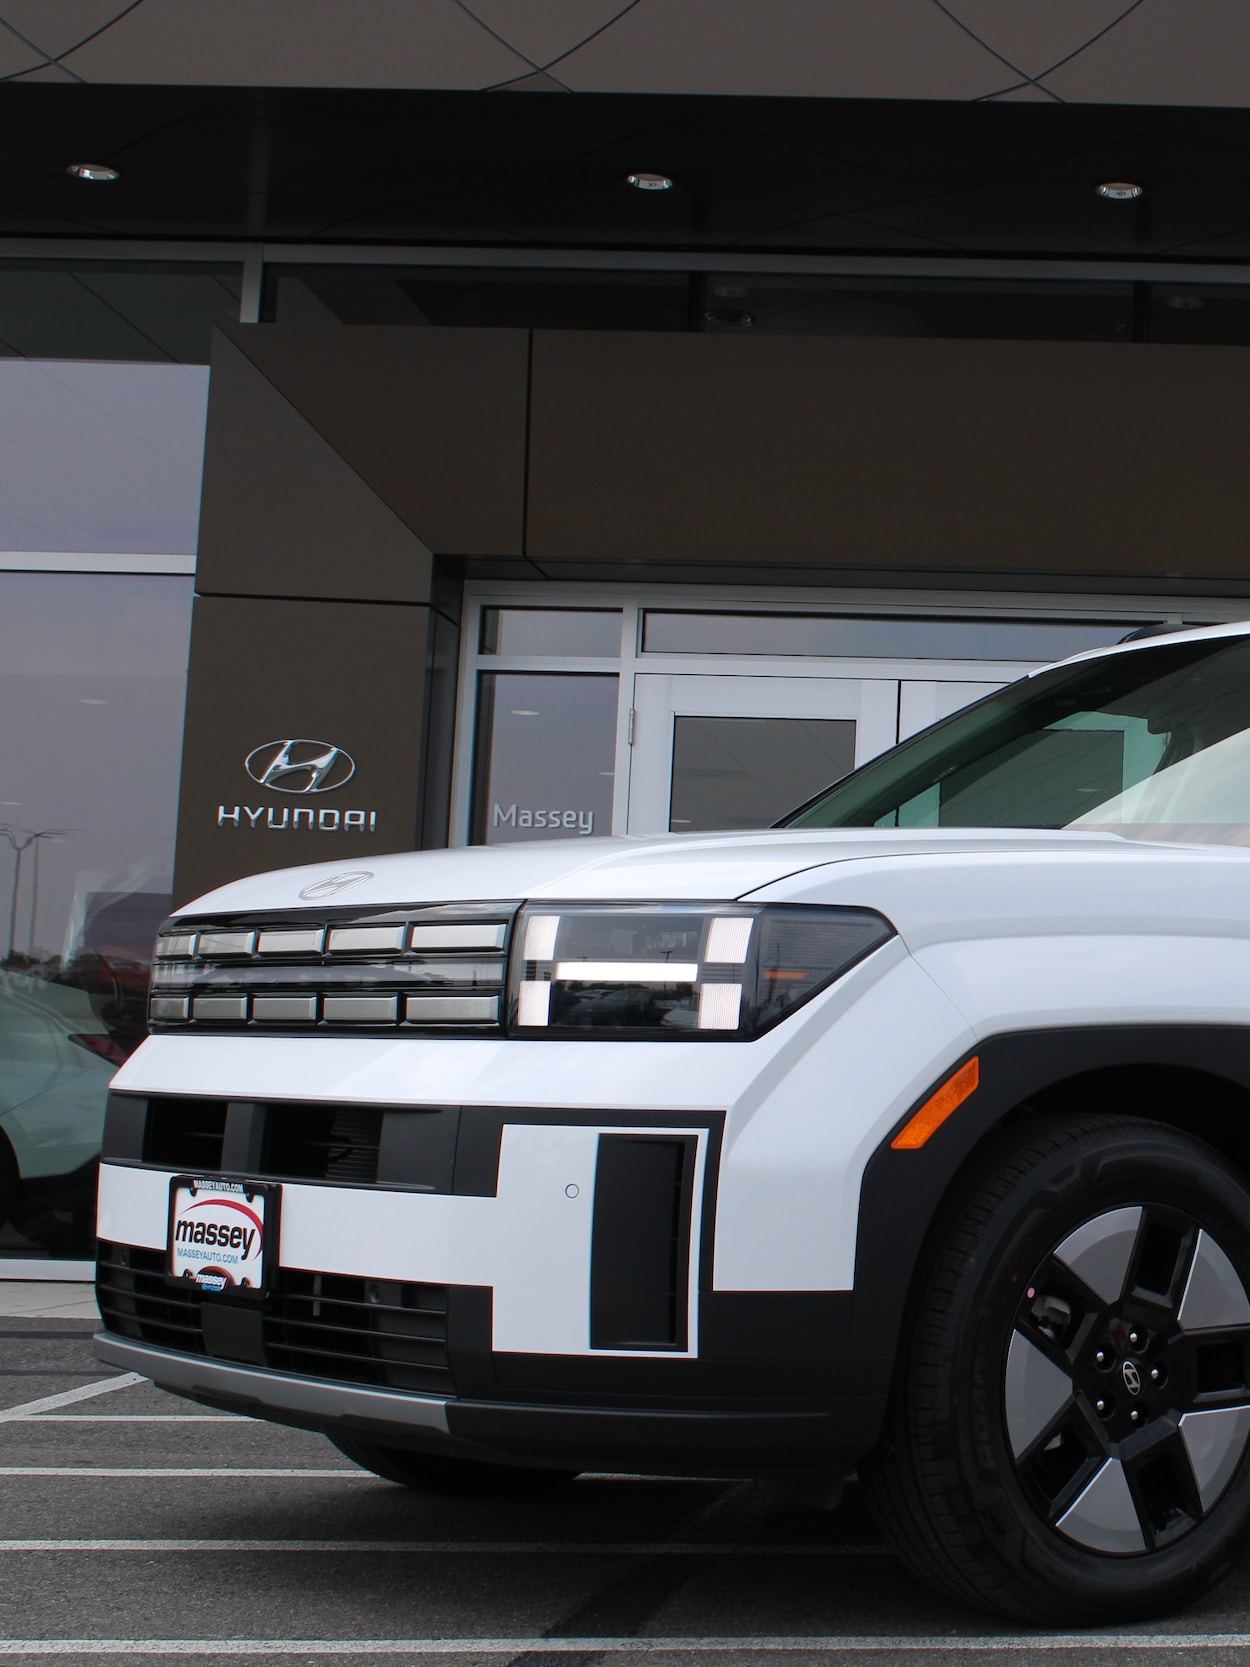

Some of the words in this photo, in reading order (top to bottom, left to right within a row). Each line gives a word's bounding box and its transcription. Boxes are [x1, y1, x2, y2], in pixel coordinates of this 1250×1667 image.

[217, 805, 377, 832] HYUNDAI
[493, 803, 594, 835] Massey
[193, 1180, 244, 1193] MASSEYAUTO.COM
[175, 1220, 255, 1260] massey
[177, 1248, 238, 1264] MASSEYAUTO.COM
[196, 1274, 226, 1289] massey
